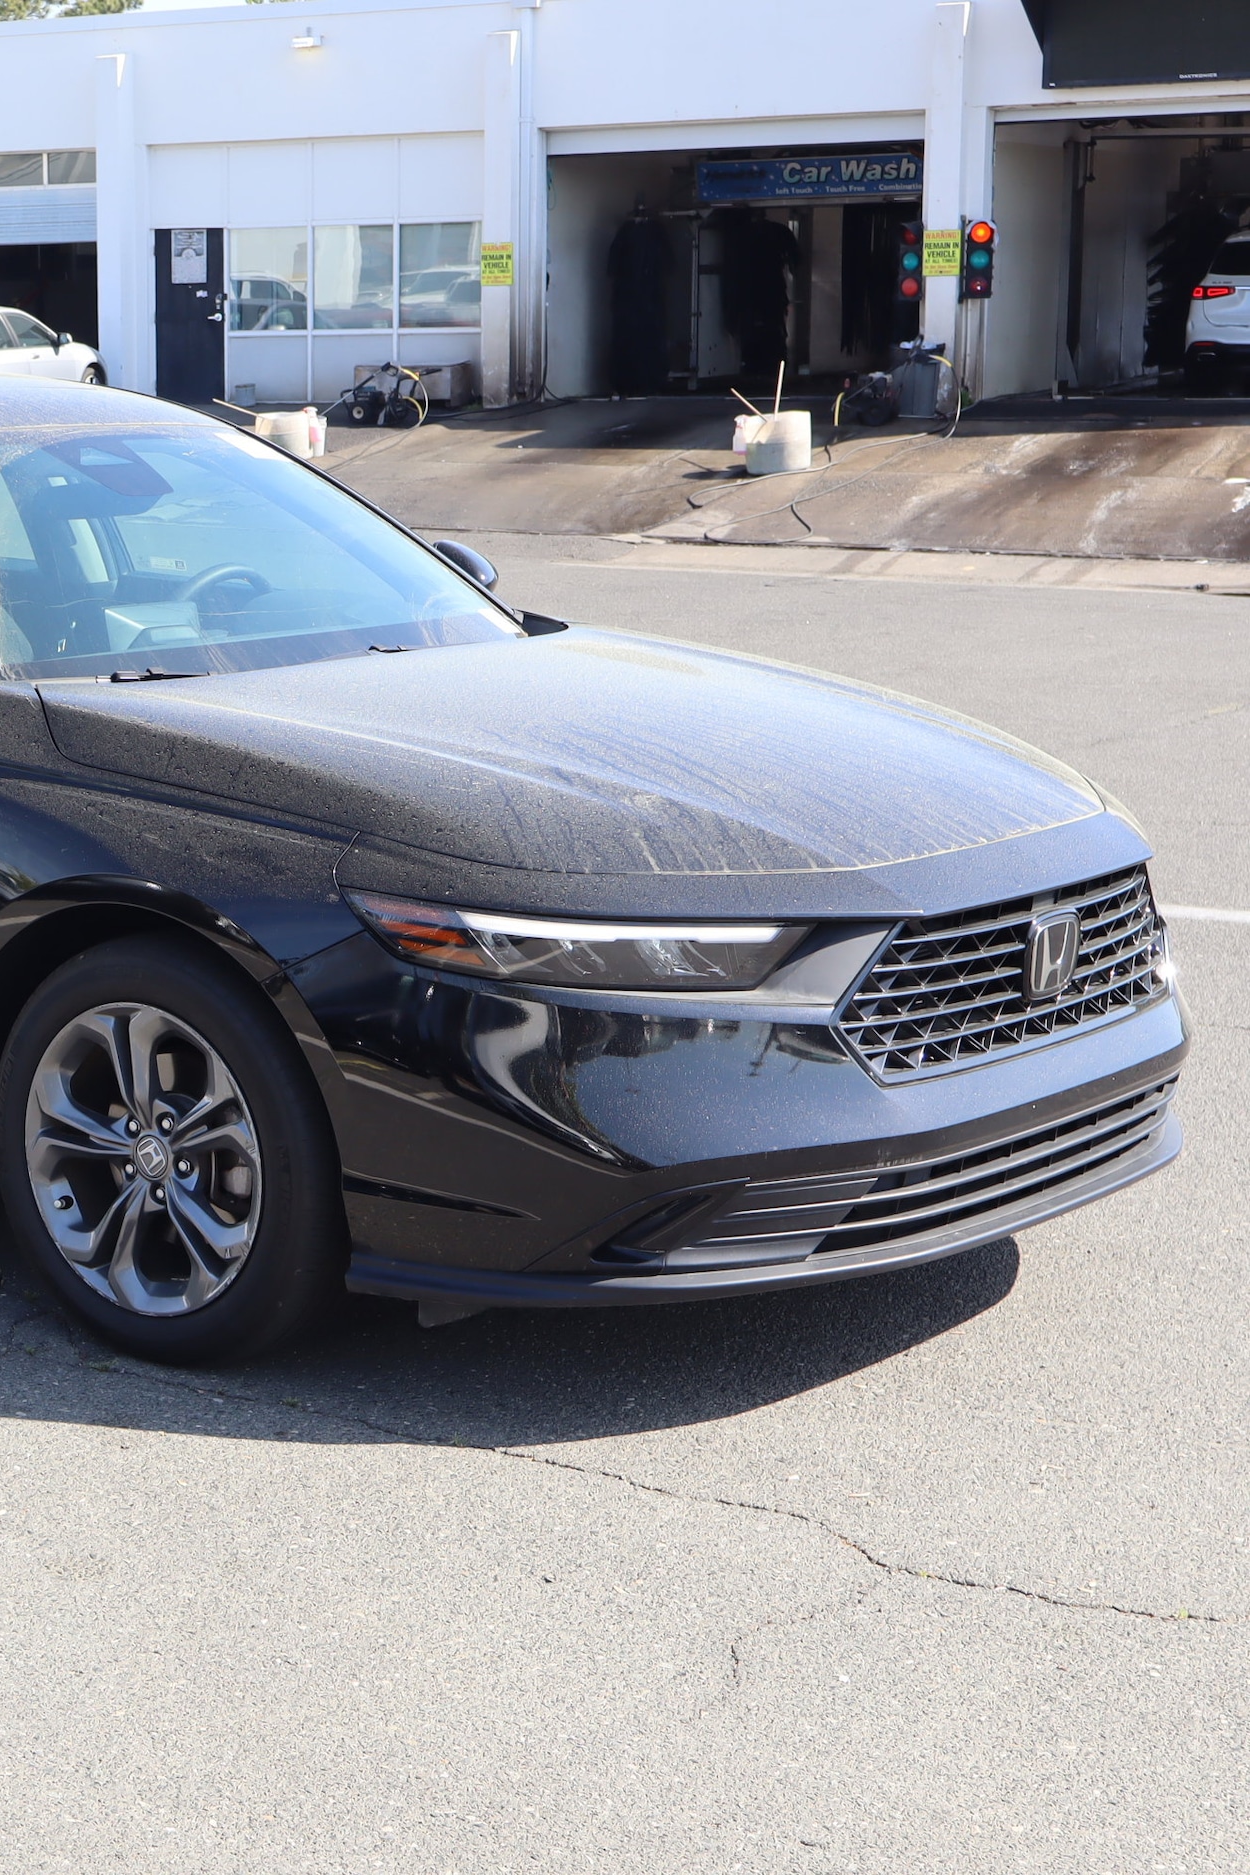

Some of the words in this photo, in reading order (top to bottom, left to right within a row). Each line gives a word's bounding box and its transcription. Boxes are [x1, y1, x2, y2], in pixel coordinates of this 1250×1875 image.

[783, 162, 831, 183] Car
[840, 158, 917, 181] Wash
[791, 186, 813, 194] Touch
[825, 184, 848, 193] Touch
[849, 183, 866, 192] Free
[925, 231, 960, 239] WARNING!
[925, 242, 951, 250] REMAIN
[927, 250, 956, 258] VEHICLE
